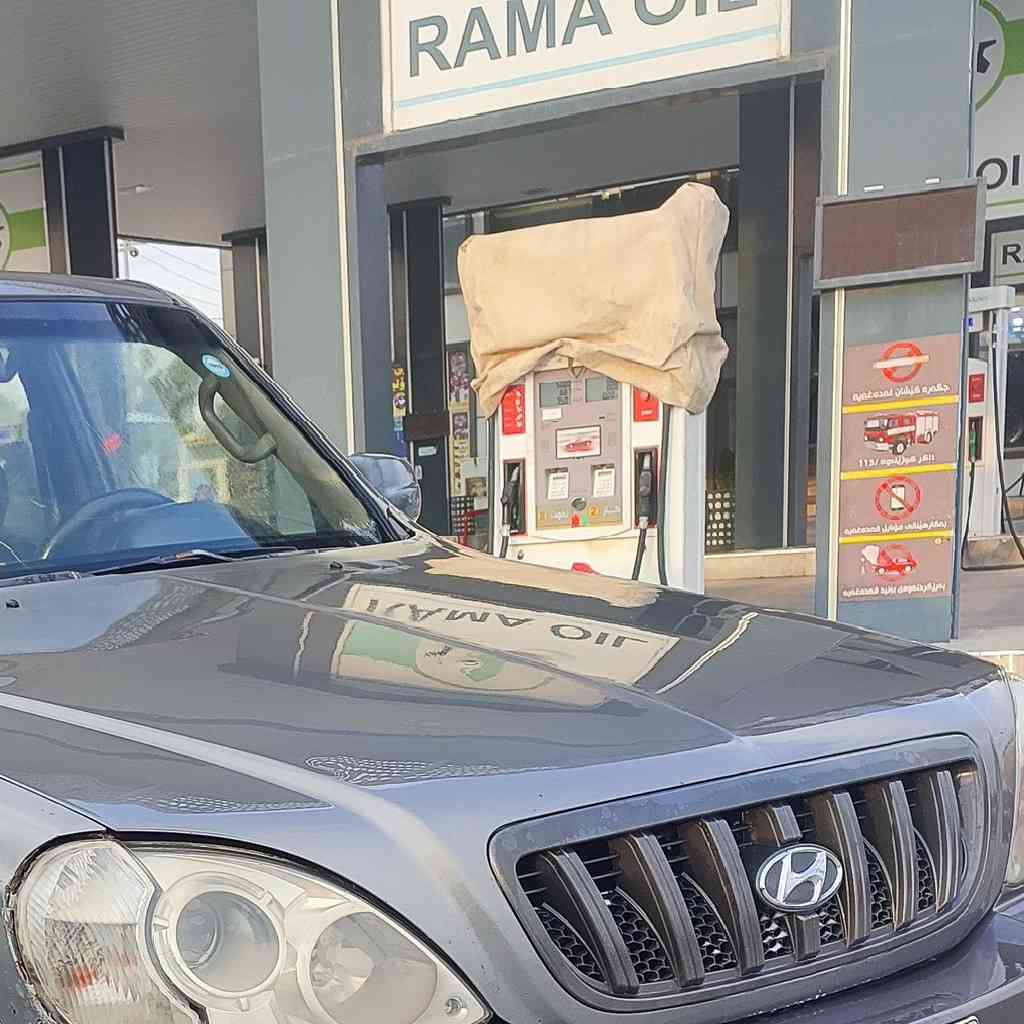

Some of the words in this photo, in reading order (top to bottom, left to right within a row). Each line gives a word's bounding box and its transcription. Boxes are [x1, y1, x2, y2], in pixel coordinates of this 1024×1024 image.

[409, 0, 612, 77] RAMA
[976, 154, 1021, 190] OI
[1002, 244, 1024, 265] R
